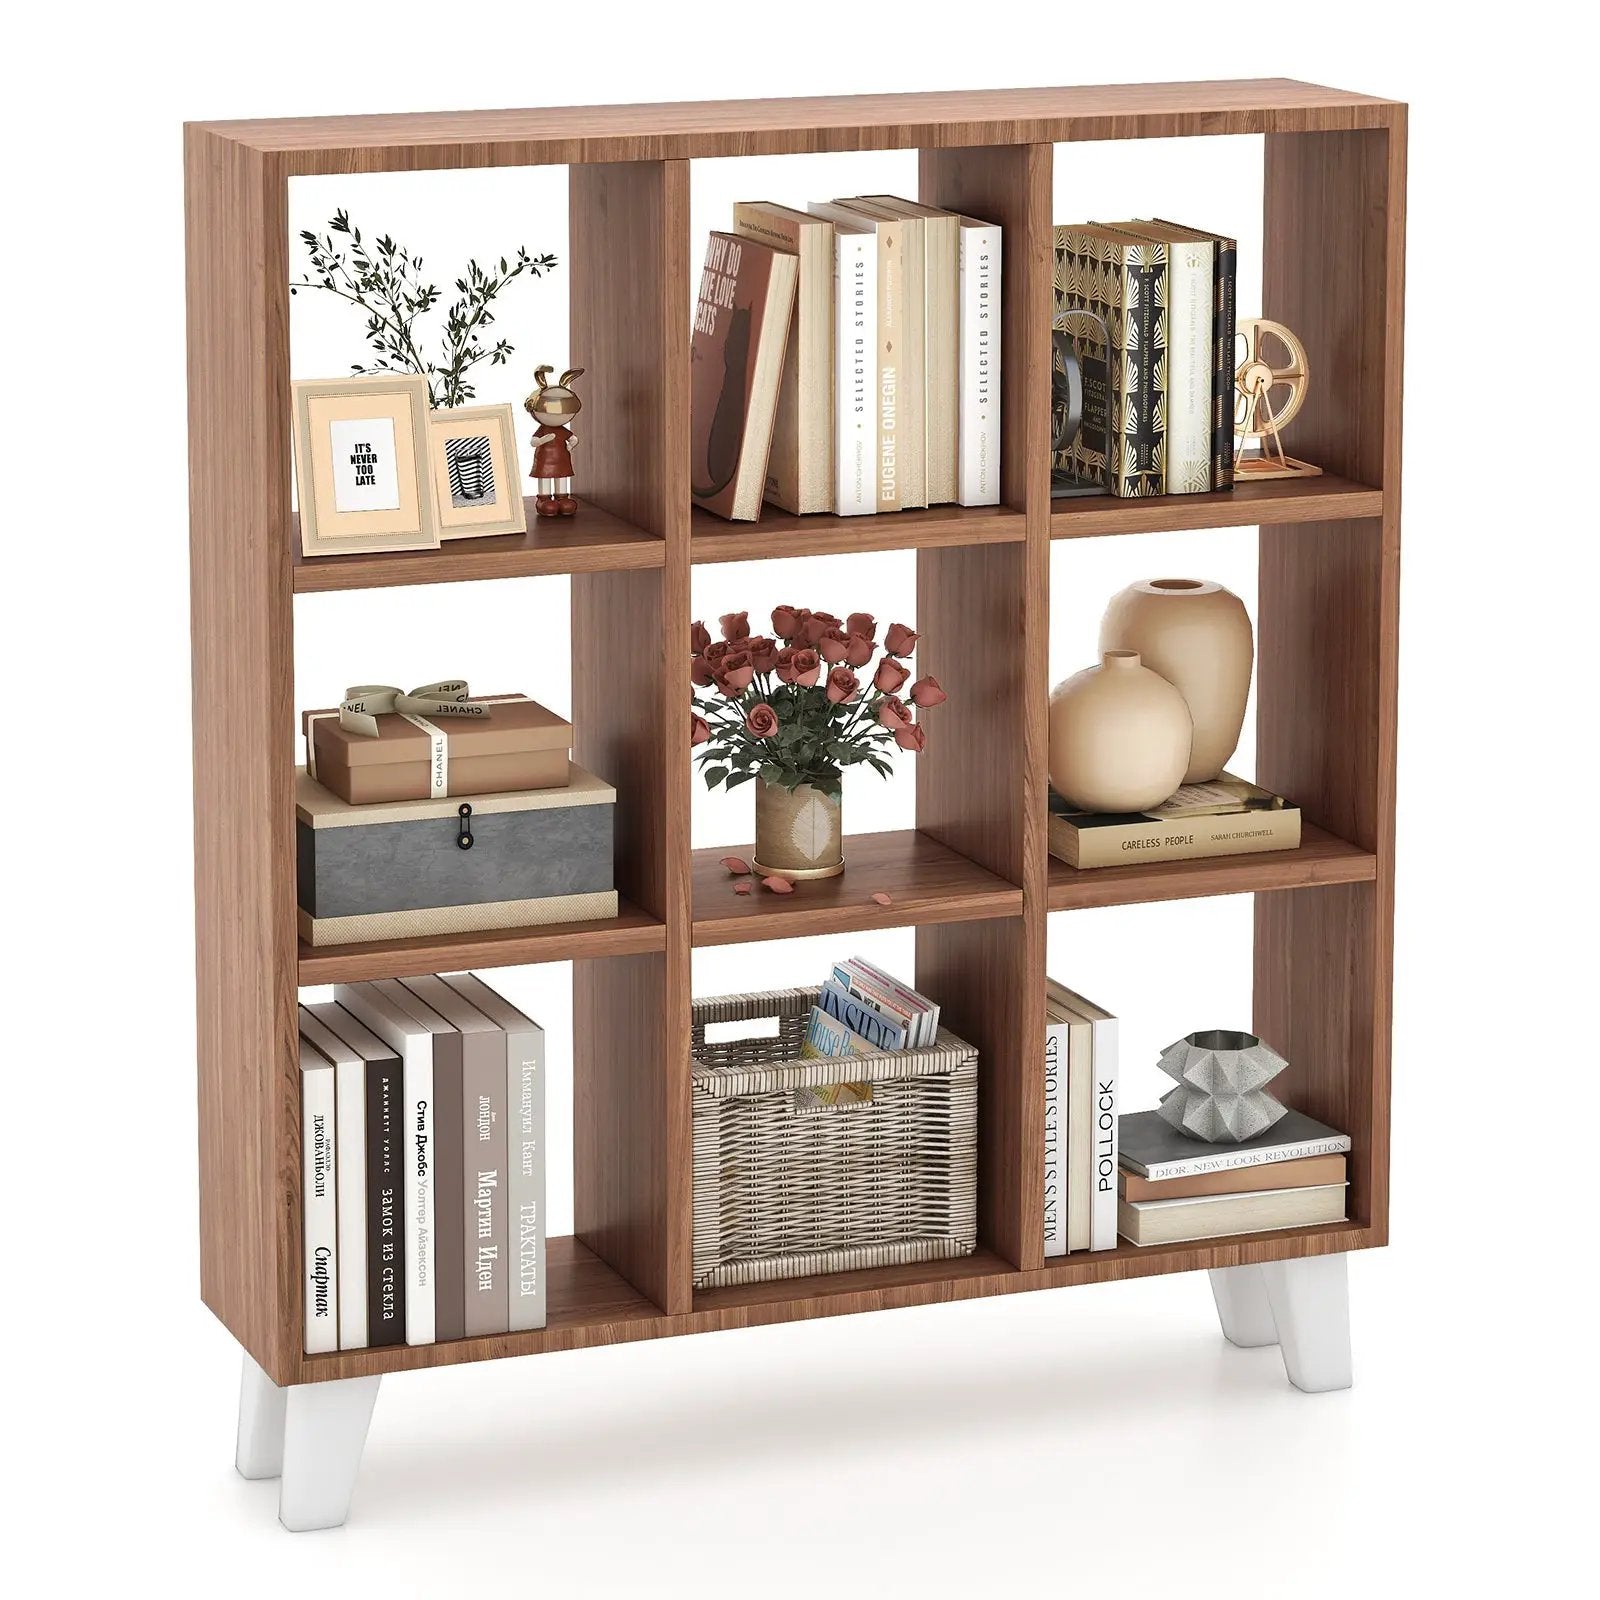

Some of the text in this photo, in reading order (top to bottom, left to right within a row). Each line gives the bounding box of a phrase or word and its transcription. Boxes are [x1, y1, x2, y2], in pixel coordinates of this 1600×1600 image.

[726, 242, 742, 277] DO
[700, 269, 737, 310] WE LOVE
[694, 301, 717, 336] CATS
[855, 262, 864, 413] SELECTED STORIES
[979, 254, 989, 404] SELECTED STORIES
[354, 443, 372, 453] IT'S
[881, 367, 896, 501] EUGENE ONEGIN
[350, 453, 378, 465] NEVER
[355, 464, 374, 475] TOO
[355, 475, 376, 486] LATE
[343, 702, 366, 714] NEL
[435, 738, 443, 788] CHANEL
[1121, 834, 1194, 851] CARELESS PEOPLE
[1210, 829, 1274, 841] SARAH CHURCHWELL
[382, 1077, 390, 1132] ДЖАННЕТТ
[477, 1095, 491, 1142] ЛОНДОН
[313, 1114, 325, 1198] ДЖОВАНЬОЛИ
[1098, 1079, 1114, 1192] POLLOCK
[1193, 1159, 1223, 1172] NEW
[1226, 1155, 1262, 1168] LOOK
[1264, 1142, 1346, 1161] REVOLUTION
[415, 1100, 429, 1287] Стив Джобс Уолтер Айзексон
[520, 1059, 537, 1297] Иммануил Кант ТРАКТАТЫ
[382, 1242, 394, 1261] из
[473, 1169, 498, 1291] Мартин Иден
[310, 1246, 332, 1318] Спартак
[382, 1266, 394, 1320] стекла
